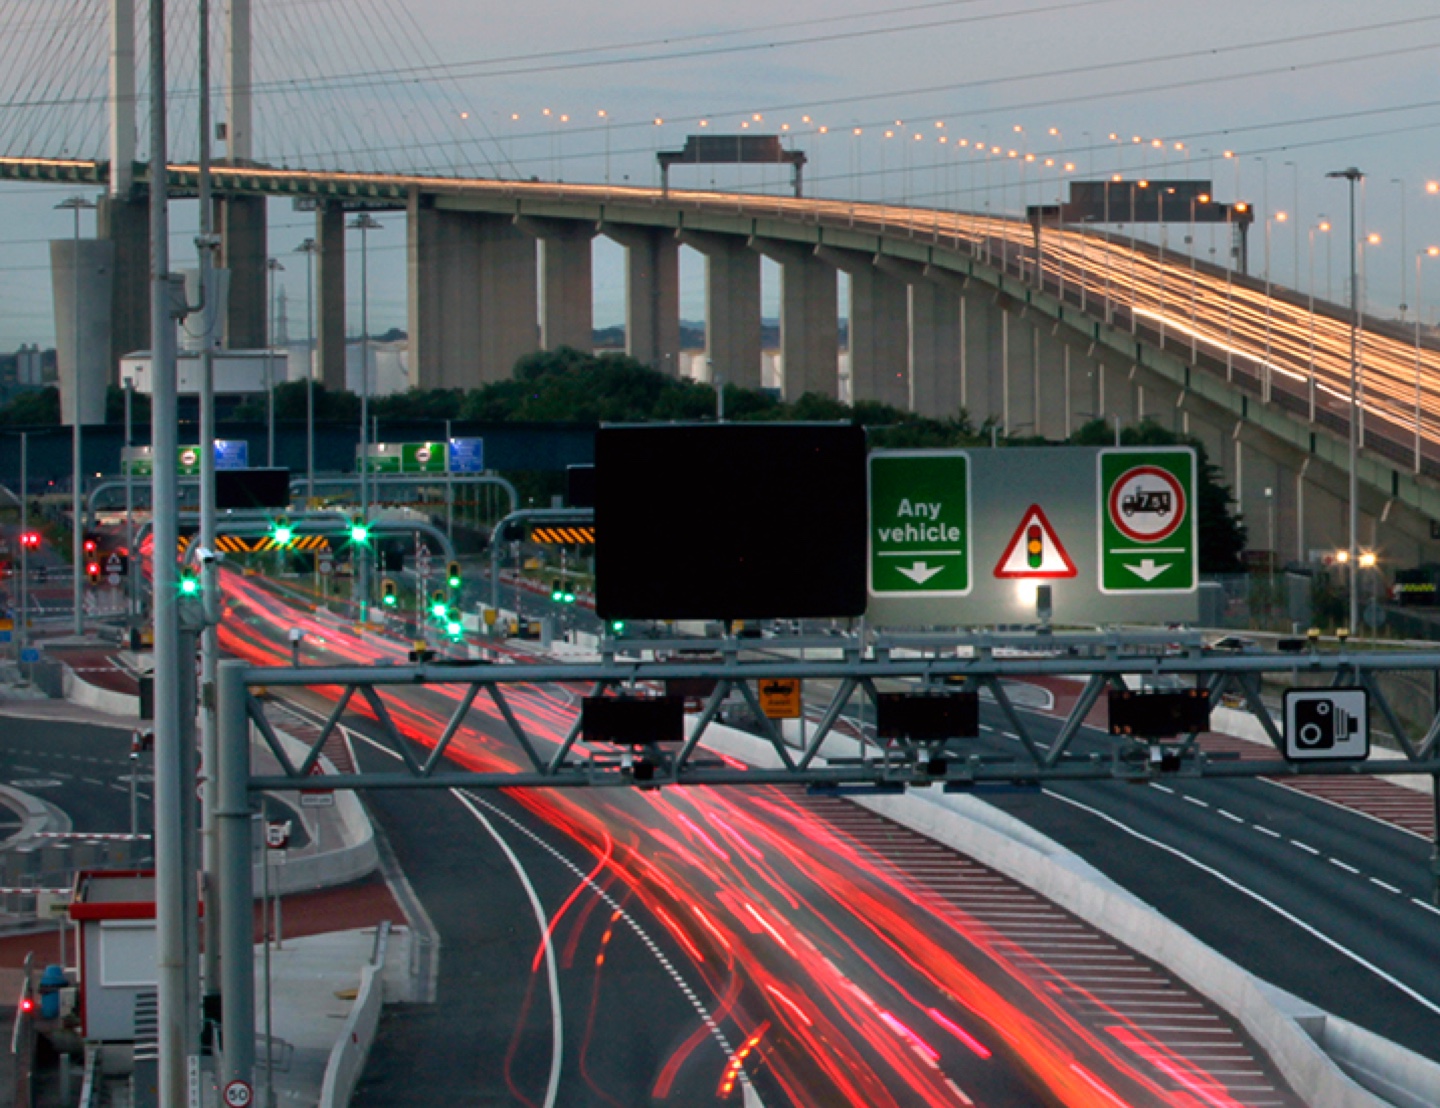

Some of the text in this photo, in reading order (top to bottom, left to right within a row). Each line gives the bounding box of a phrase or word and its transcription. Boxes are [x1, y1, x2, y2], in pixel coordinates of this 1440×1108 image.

[897, 498, 941, 521] Any
[878, 522, 961, 542] vehicle
[228, 1088, 249, 1102] 50
